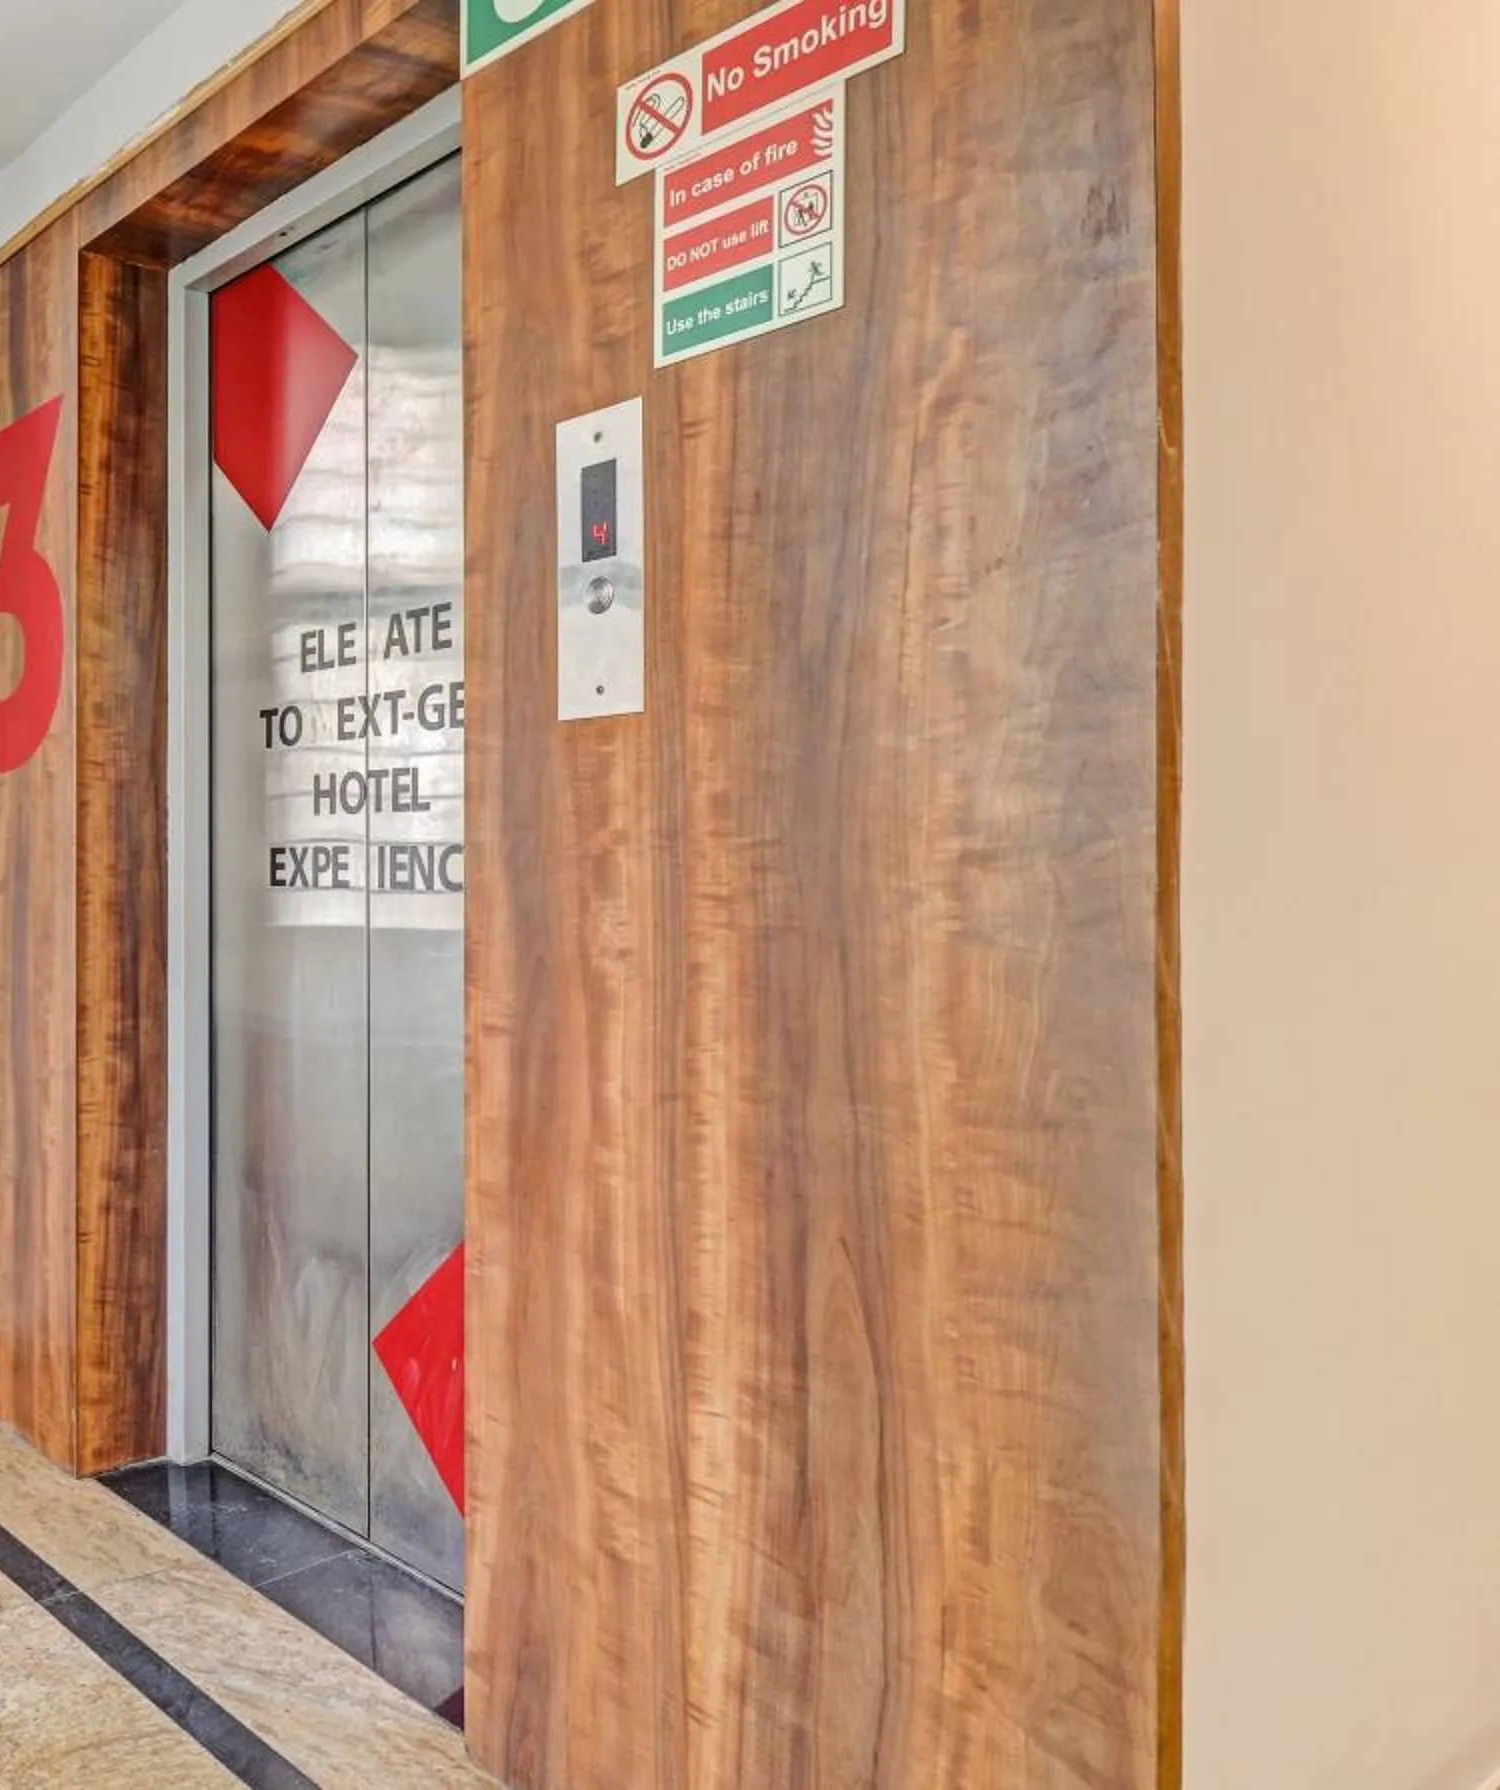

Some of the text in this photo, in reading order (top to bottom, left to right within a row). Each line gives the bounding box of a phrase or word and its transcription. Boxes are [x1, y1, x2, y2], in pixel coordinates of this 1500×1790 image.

[707, 66, 745, 102] No
[753, 0, 887, 78] Smoking
[670, 139, 799, 207] In case of fire
[667, 218, 769, 271] DO NOT use lift
[666, 288, 770, 335] Use the stairs
[592, 519, 609, 546] 4
[300, 602, 453, 673] ELEATE
[259, 705, 302, 749] TO
[313, 767, 431, 816] HOTEL
